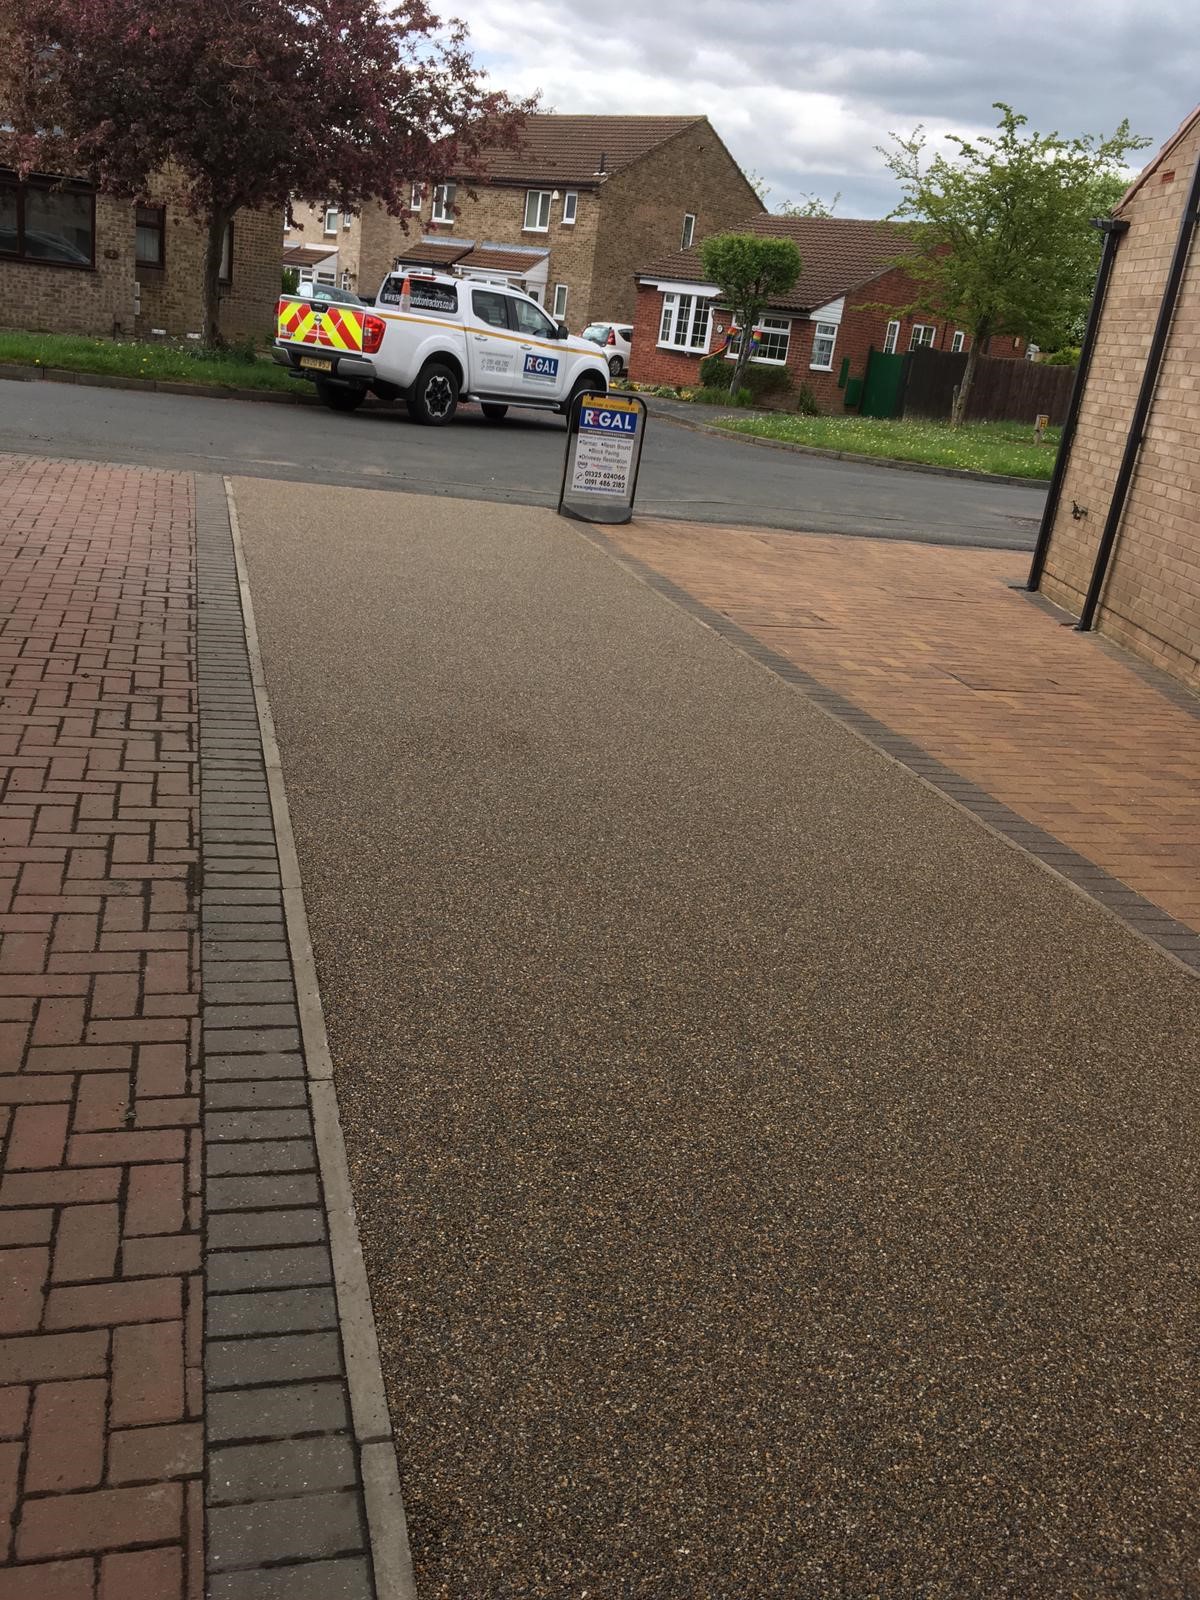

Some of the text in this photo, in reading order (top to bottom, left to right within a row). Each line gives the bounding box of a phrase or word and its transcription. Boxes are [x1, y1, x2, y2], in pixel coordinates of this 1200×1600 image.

[526, 356, 555, 374] REGAL
[584, 409, 632, 430] REGAL
[584, 470, 626, 481] 01325 624066
[612, 481, 626, 489] 2182
